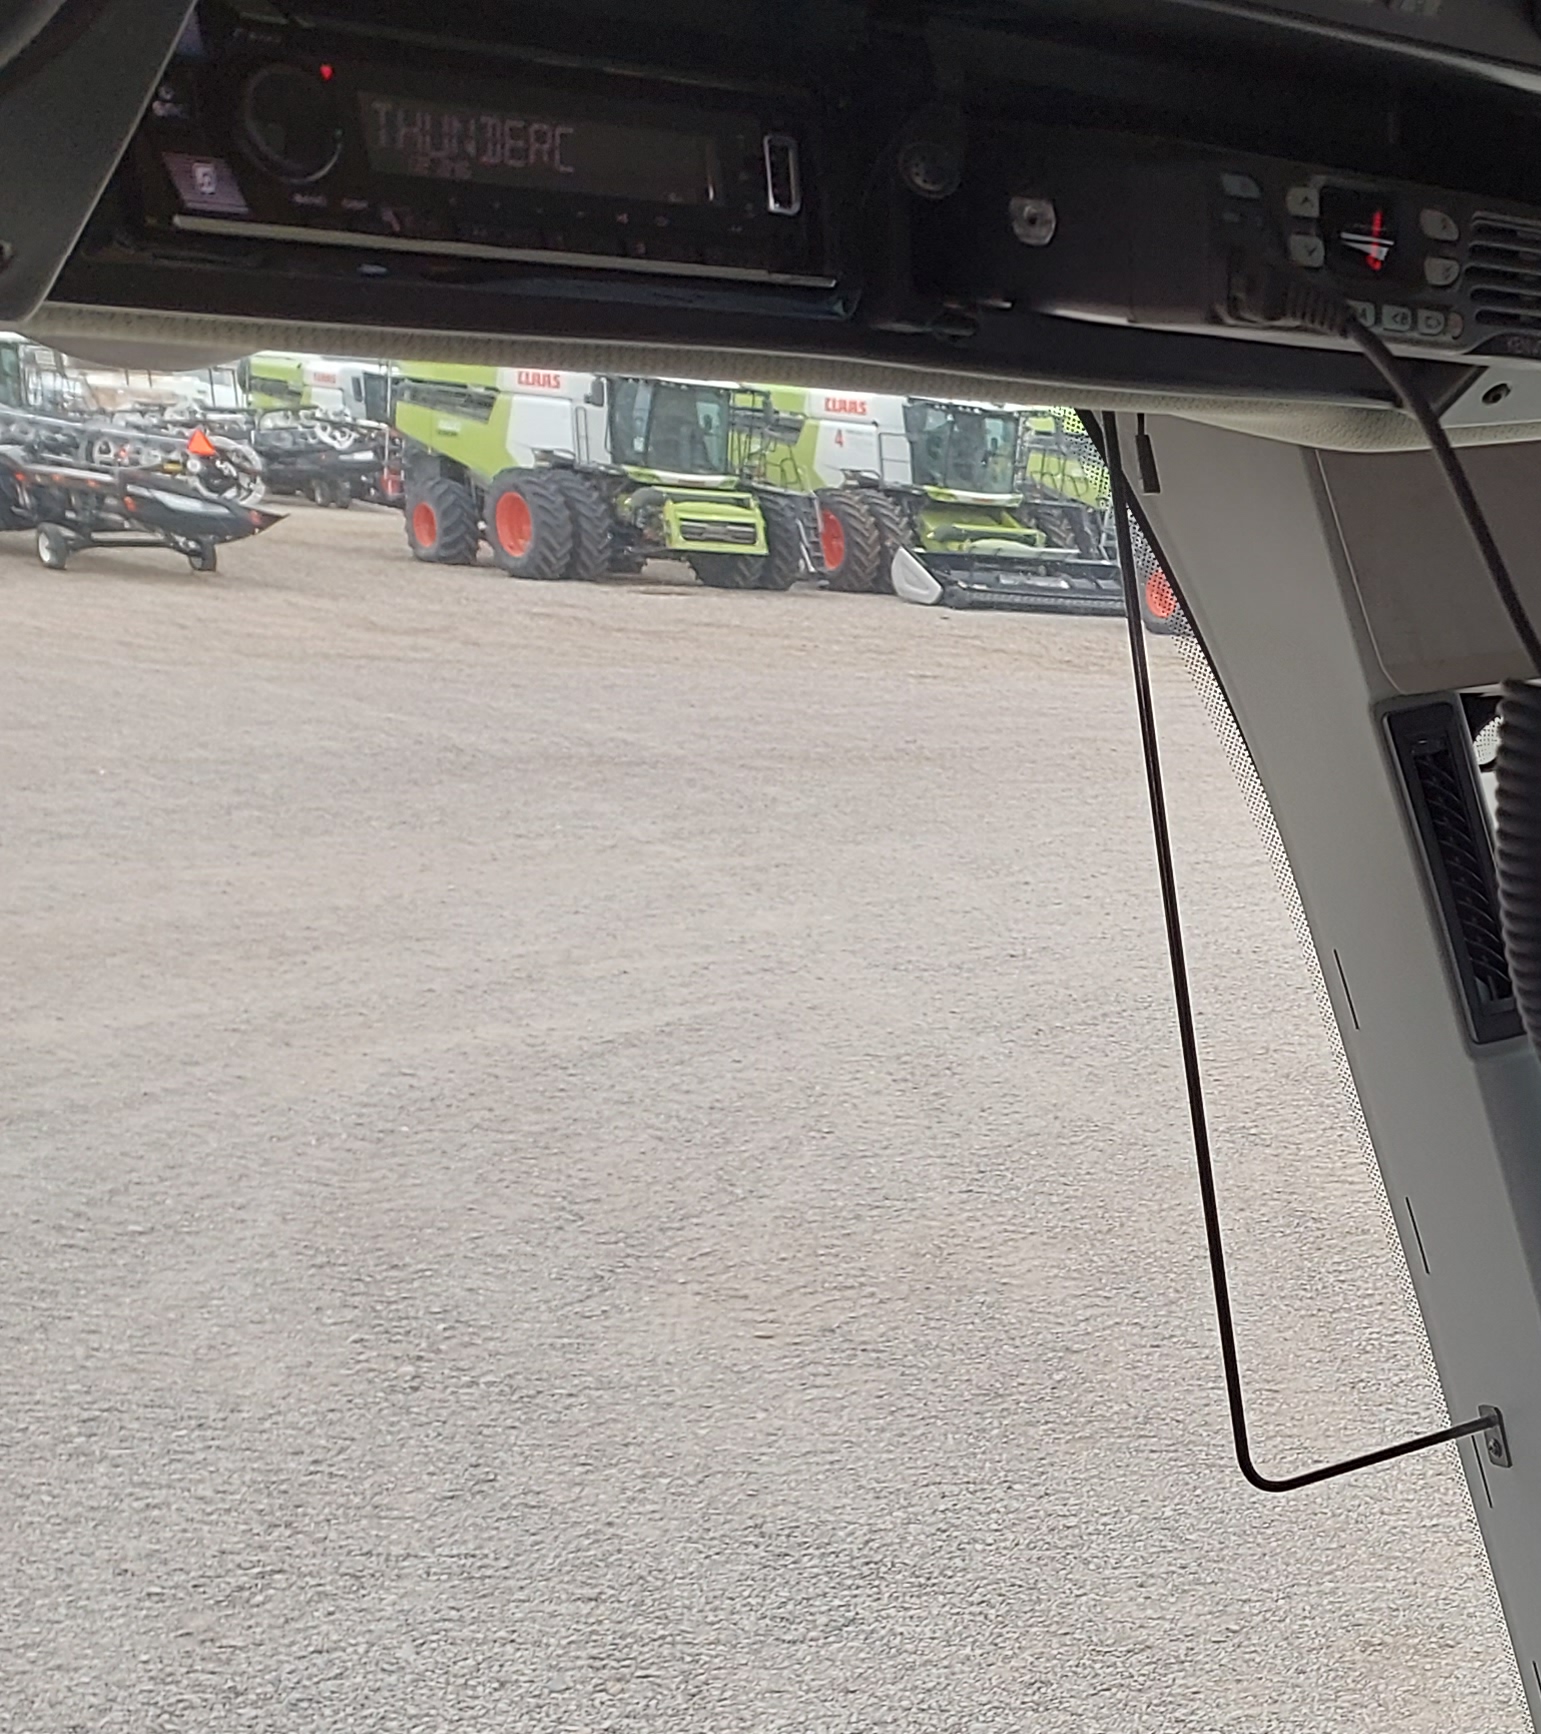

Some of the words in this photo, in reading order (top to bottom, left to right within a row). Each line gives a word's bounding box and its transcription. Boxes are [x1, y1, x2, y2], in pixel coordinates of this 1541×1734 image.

[517, 370, 561, 389] CLAAS
[824, 397, 867, 416] CLAAS
[834, 429, 844, 448] 4
